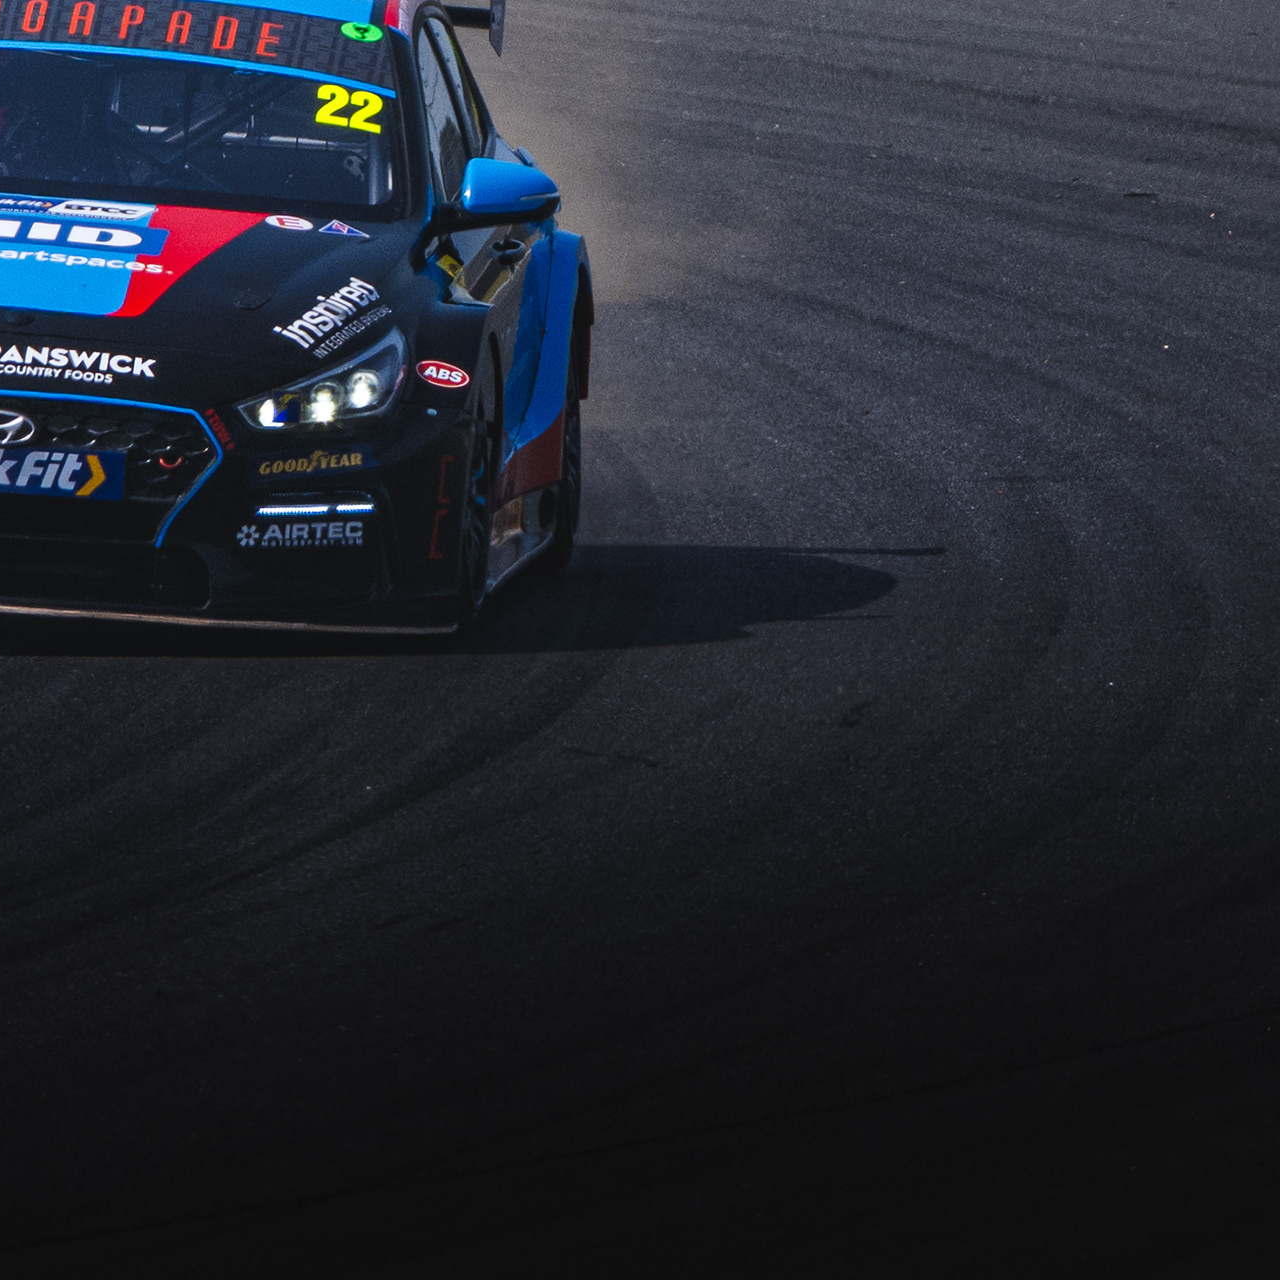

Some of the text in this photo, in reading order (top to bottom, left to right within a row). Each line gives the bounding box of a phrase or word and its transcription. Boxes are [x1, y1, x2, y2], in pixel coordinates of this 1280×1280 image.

[315, 84, 383, 134] 22
[273, 276, 380, 349] inspired
[64, 368, 113, 384] FOODS
[423, 366, 462, 383] ABS
[259, 451, 363, 475] GOODYEAR
[262, 521, 363, 540] AIRTEC
